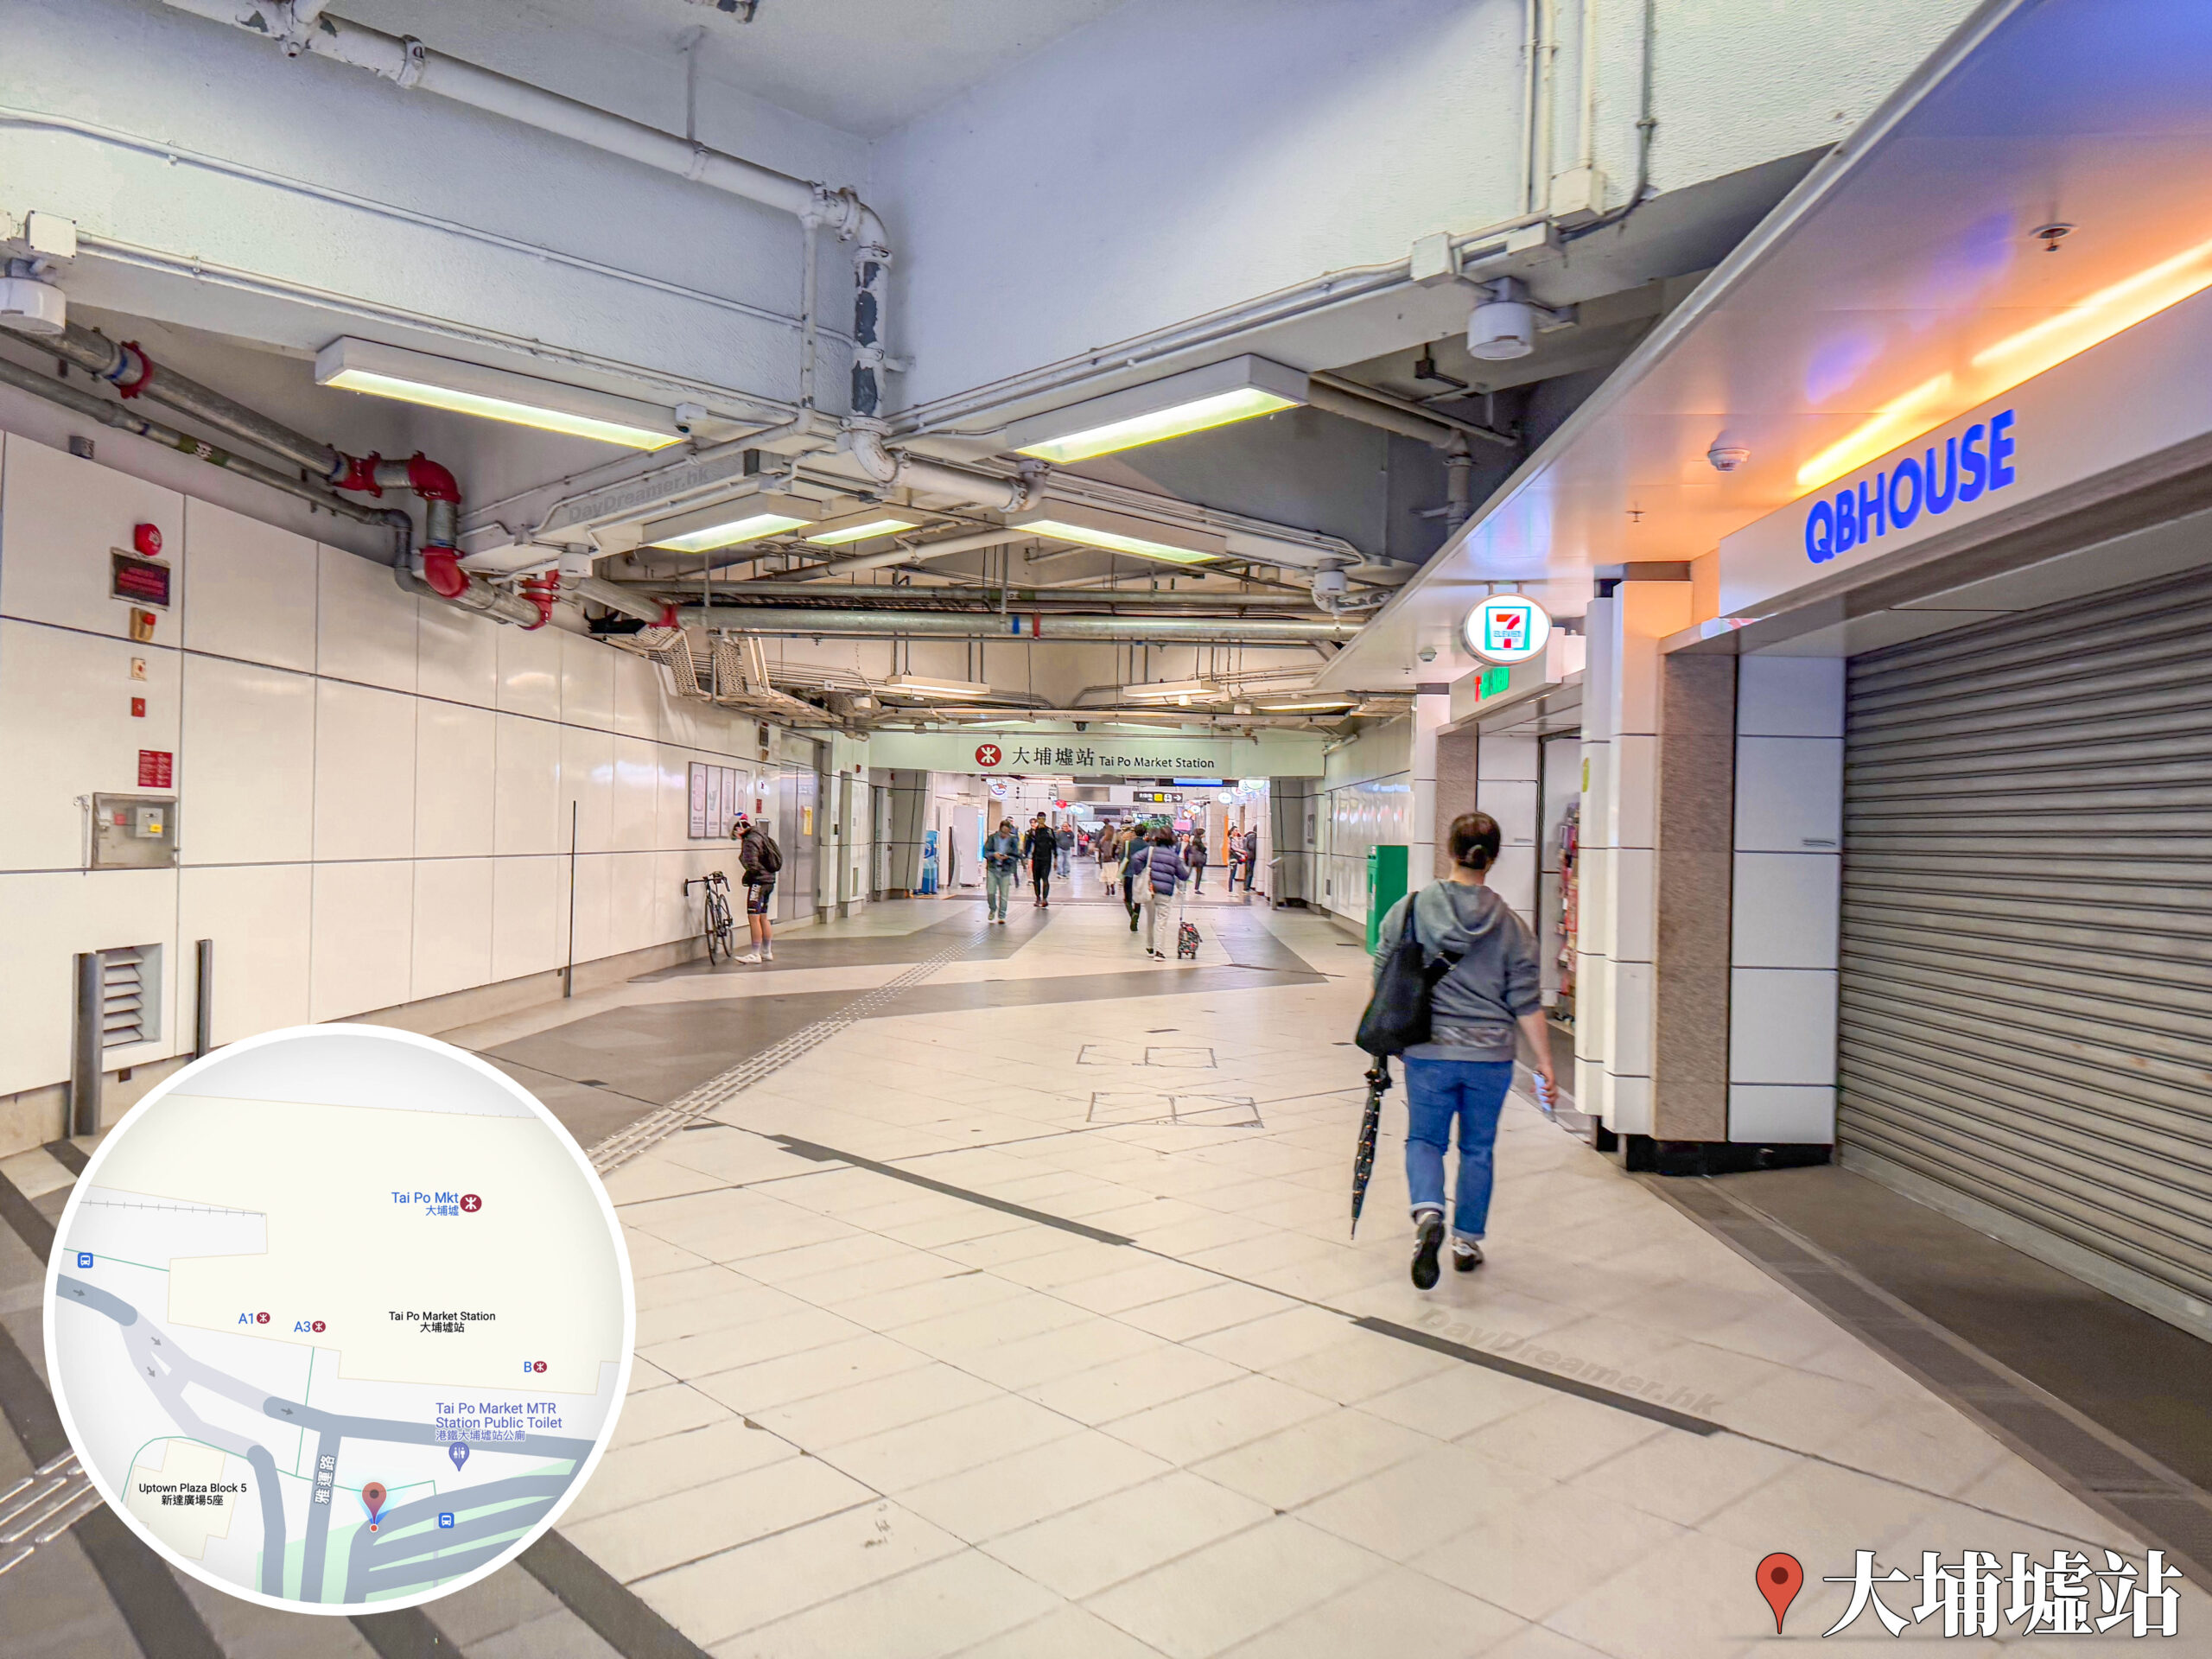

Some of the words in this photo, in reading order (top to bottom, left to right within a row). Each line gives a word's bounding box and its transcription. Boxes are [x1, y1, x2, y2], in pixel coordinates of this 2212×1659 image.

[1805, 409, 2015, 563] QBHOUSE
[1012, 746, 1095, 766] 大埔墟站
[1099, 755, 1115, 766] Tai
[1117, 756, 1131, 767] Po
[1134, 756, 1173, 767] Market
[1175, 757, 1215, 768] Station
